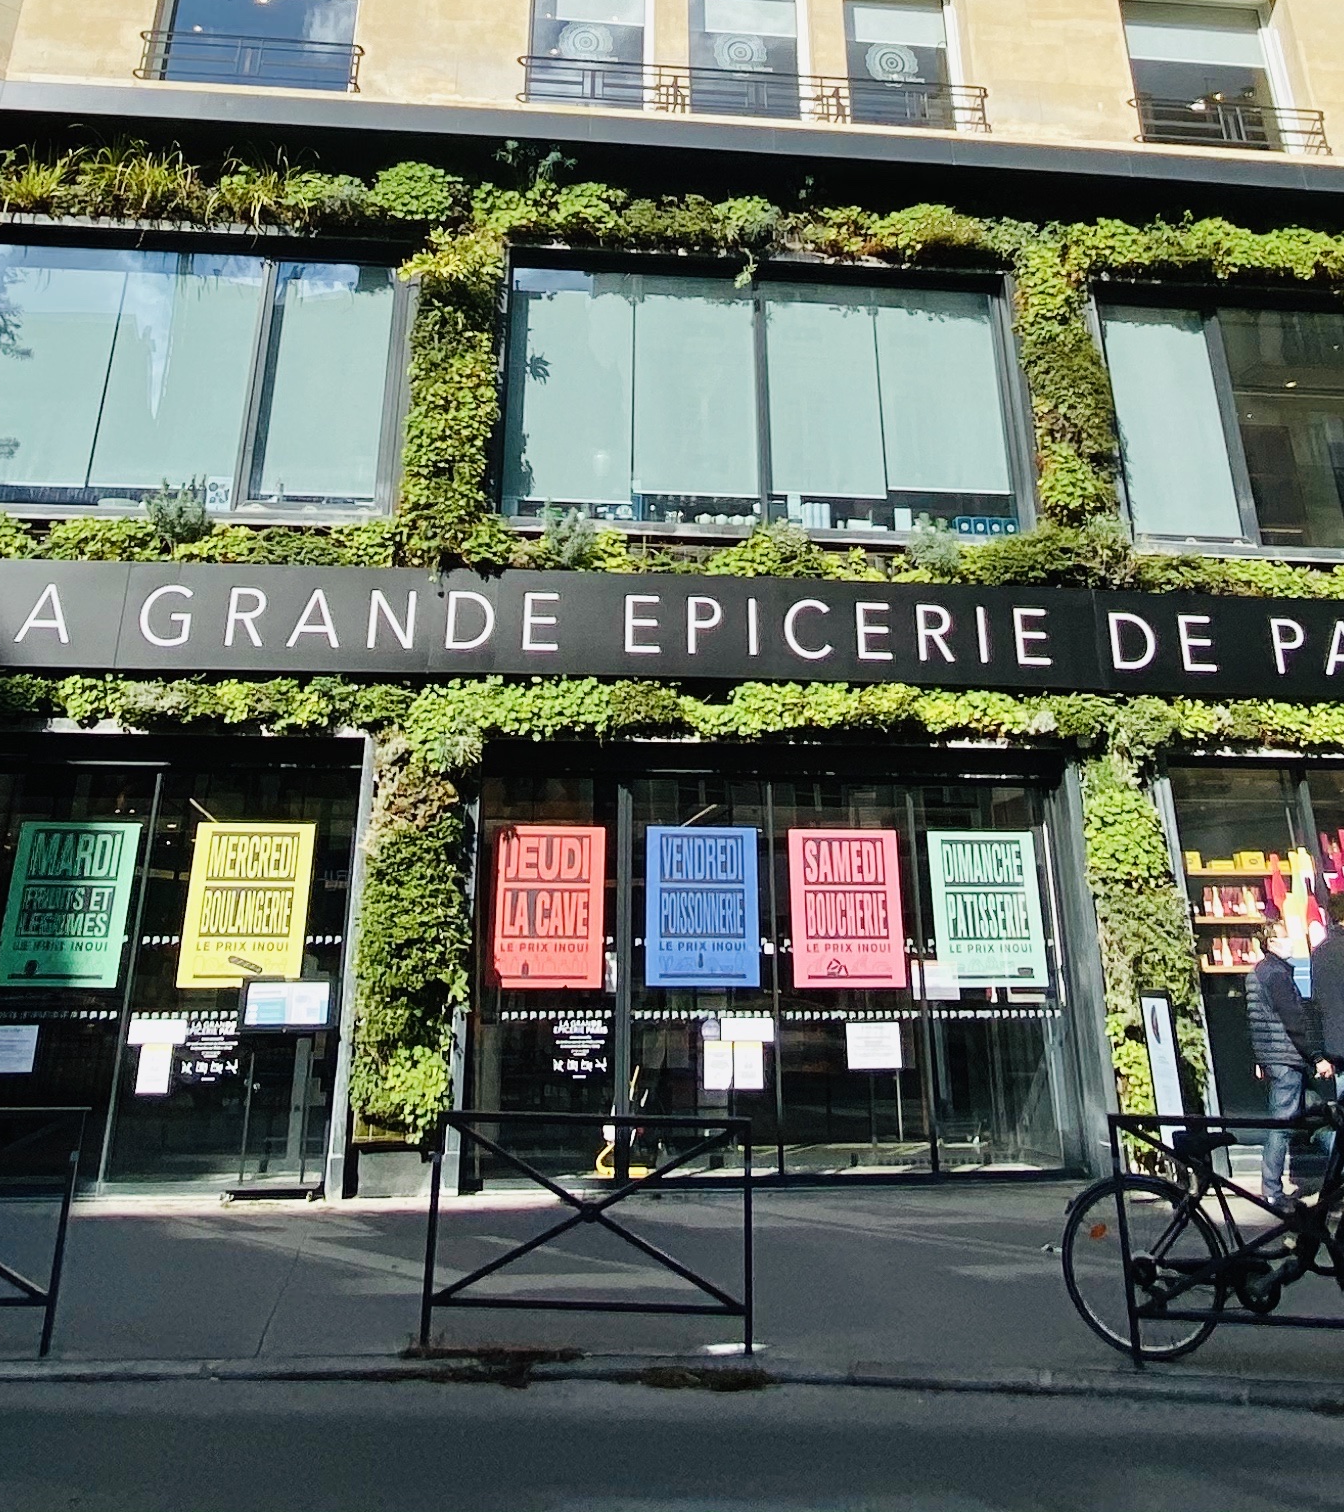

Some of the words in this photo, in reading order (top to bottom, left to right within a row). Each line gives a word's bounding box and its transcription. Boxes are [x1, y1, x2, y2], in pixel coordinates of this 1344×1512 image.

[138, 583, 560, 653] GRANDE
[624, 593, 1053, 667] EPICERIE
[1107, 610, 1219, 673] DE
[29, 833, 123, 876] MARDI
[207, 835, 299, 878] MERCREDI
[506, 836, 589, 881] JEUDI
[661, 837, 743, 880] VENDREDI
[804, 840, 885, 883] SAMEDI
[942, 843, 1024, 884] DIMANCHE
[89, 888, 113, 911] ET
[200, 890, 292, 934] BOULANGERIE
[503, 891, 529, 936] LA
[535, 891, 589, 936] CAVE
[661, 891, 744, 935] POISSONNERIE
[807, 892, 888, 937] BOUCHERIE
[946, 893, 1030, 938] PATISSERIE
[196, 941, 209, 951] LE
[216, 941, 247, 952] PRIX
[252, 941, 290, 952] INOUI
[500, 943, 514, 953] LE
[519, 943, 549, 953] PRIX
[659, 941, 673, 952] LE
[678, 941, 707, 952] PRIX
[806, 943, 820, 953] LE
[825, 943, 853, 953] PRIX
[949, 944, 962, 954] LE
[968, 944, 995, 954] PRIX
